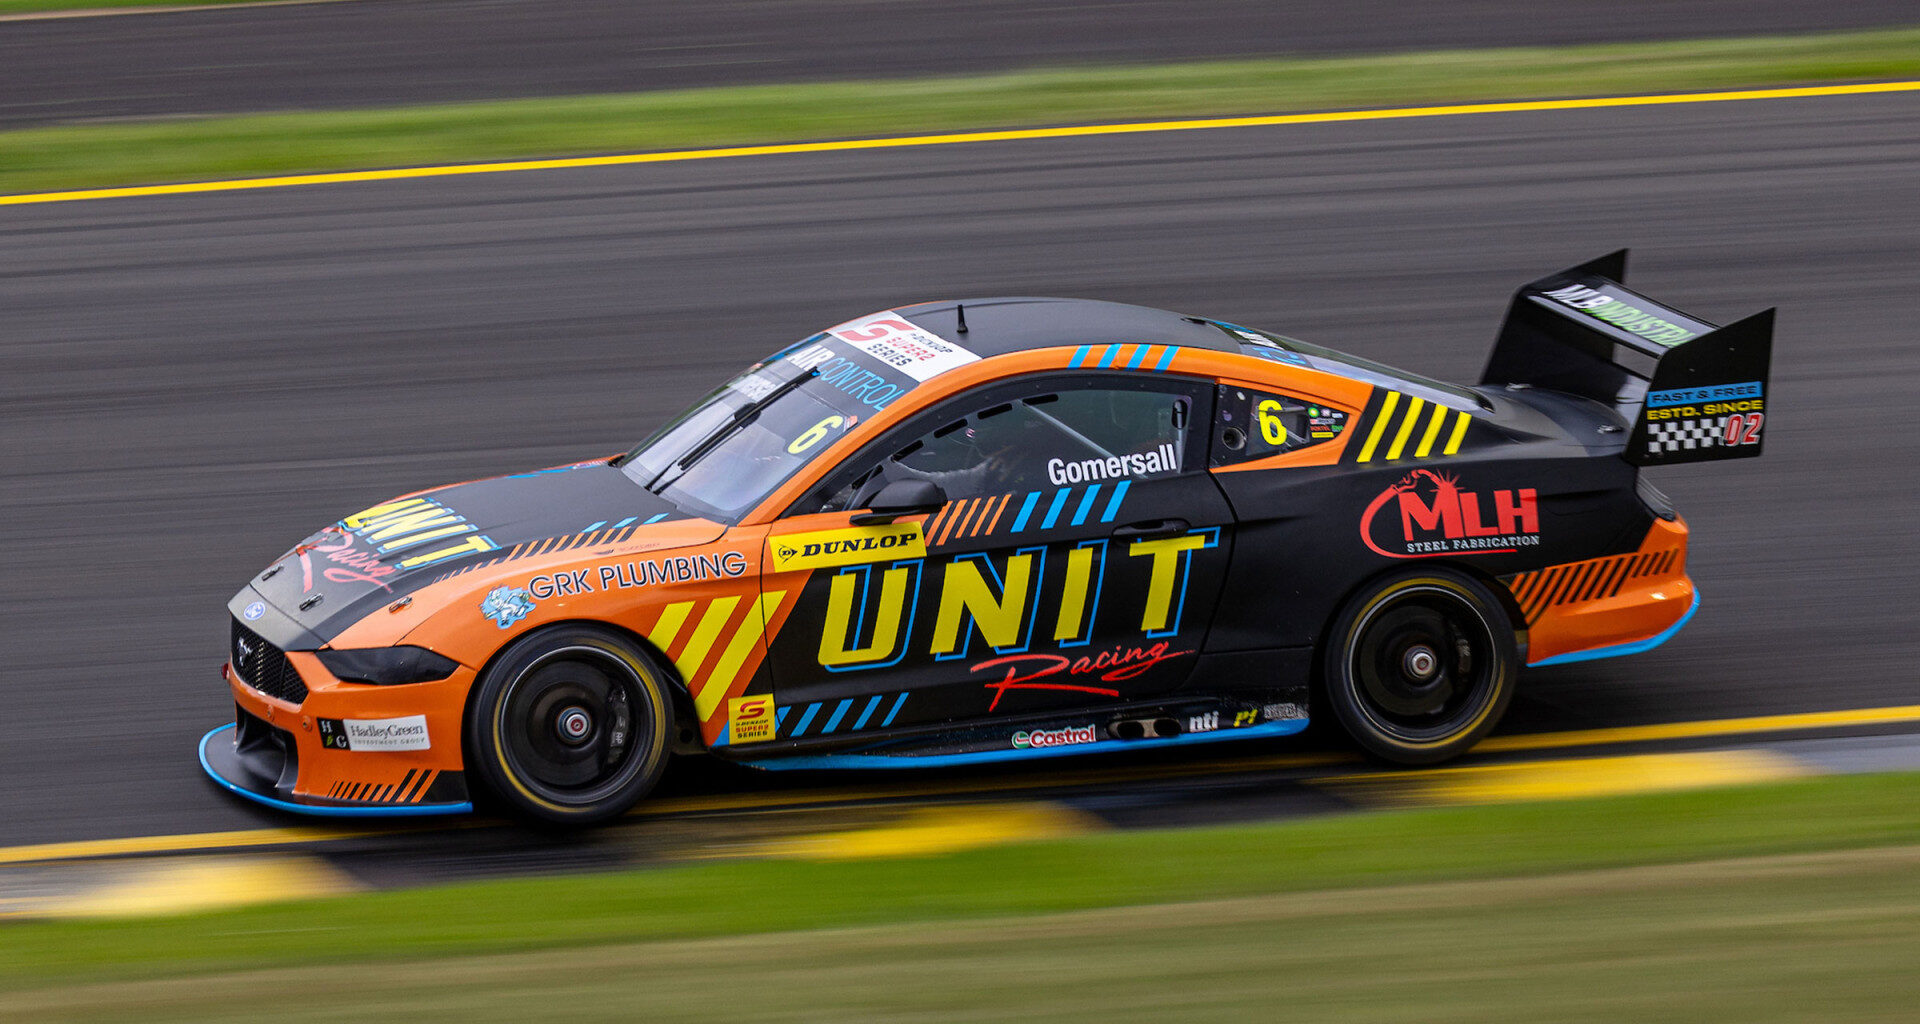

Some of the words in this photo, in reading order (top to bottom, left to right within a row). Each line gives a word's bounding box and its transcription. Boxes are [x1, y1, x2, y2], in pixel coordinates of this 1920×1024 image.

[1541, 284, 1614, 309] MLB
[867, 343, 912, 366] SERIES
[886, 337, 935, 361] SUPER2
[786, 344, 835, 372] AIR
[818, 357, 905, 412] CONTROL
[1653, 391, 1693, 403] FAST
[1699, 390, 1709, 400] &
[1714, 385, 1758, 398] FREE
[1258, 399, 1288, 445] 6
[1647, 406, 1701, 420] ESTD.
[1703, 400, 1764, 415] SINCE
[787, 415, 844, 454] 6
[1724, 412, 1764, 447] 02
[1048, 444, 1177, 486] Gomersall
[1398, 482, 1540, 541] MLH
[338, 497, 502, 571] UNIT
[801, 533, 917, 557] DUNLOP
[1407, 540, 1449, 553] STEEL
[1453, 535, 1540, 549] FABRICATION
[296, 526, 397, 594] Racing
[529, 567, 594, 600] GRK
[600, 551, 747, 590] PLUMBING
[818, 527, 1220, 673] UNIT
[970, 640, 1194, 712] Racing
[350, 724, 424, 739] HadleyGreen
[736, 724, 769, 732] SUPER2
[1030, 724, 1096, 747] Castrol
[1189, 711, 1219, 732] nti
